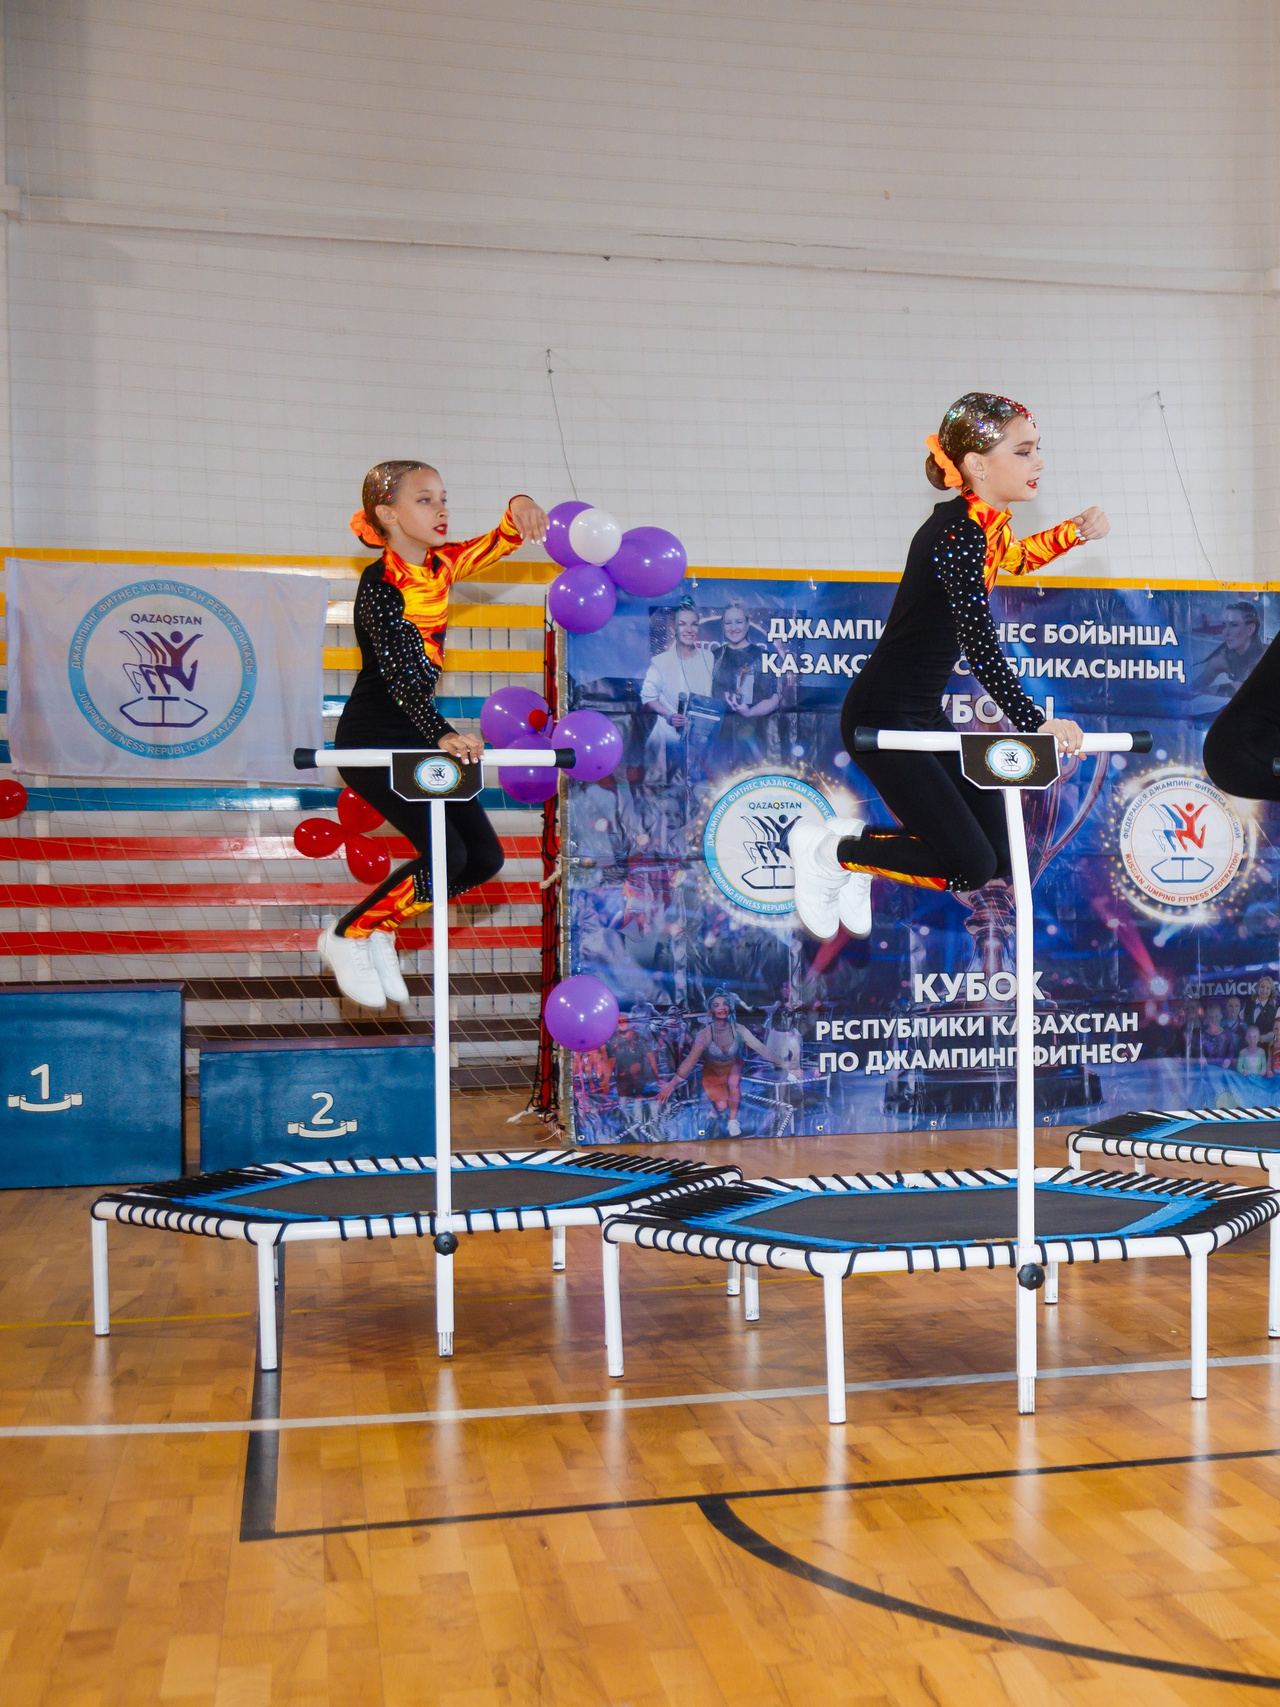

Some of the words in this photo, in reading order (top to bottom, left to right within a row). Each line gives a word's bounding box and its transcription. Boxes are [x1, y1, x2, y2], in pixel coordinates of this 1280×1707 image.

[99, 587, 140, 612] ФИТНЕС
[131, 613, 202, 625] QAZAQSTAN
[767, 618, 887, 642] ДЖАМПИ
[995, 622, 1037, 644] НЕС
[1044, 620, 1179, 646] БОЙЫНША
[762, 652, 872, 677] ҚАЗАҚС
[78, 690, 106, 730] JUMPING
[106, 728, 145, 753] FITNESS
[148, 743, 197, 756] REPUBLIC
[199, 736, 211, 748] OF
[706, 801, 729, 846] ДЖАМПИНГ
[728, 781, 759, 801] ФИТНЕС
[749, 801, 802, 810] QAZAQSTAN
[1123, 793, 1148, 839] ФЕДЕРАЦИЯ
[1194, 783, 1226, 808] ФИТНЕСА
[1225, 807, 1241, 839] РОССИИ
[711, 867, 734, 896] JUMPING
[734, 893, 761, 910] FITNESS
[1125, 853, 1144, 885] RUSSIAN
[1144, 884, 1176, 902] JUMPING
[1178, 891, 1210, 903] FITNESS
[1210, 852, 1240, 894] FEDERATION
[816, 1016, 985, 1041] РЕСПУБЛИКИ
[819, 1052, 860, 1074] ПО
[865, 1046, 1018, 1075] ДЖАМПИНГ
[1033, 1043, 1144, 1067] ФИТНЕСУ
[30, 1063, 50, 1100] 1
[311, 1092, 335, 1125] 2
